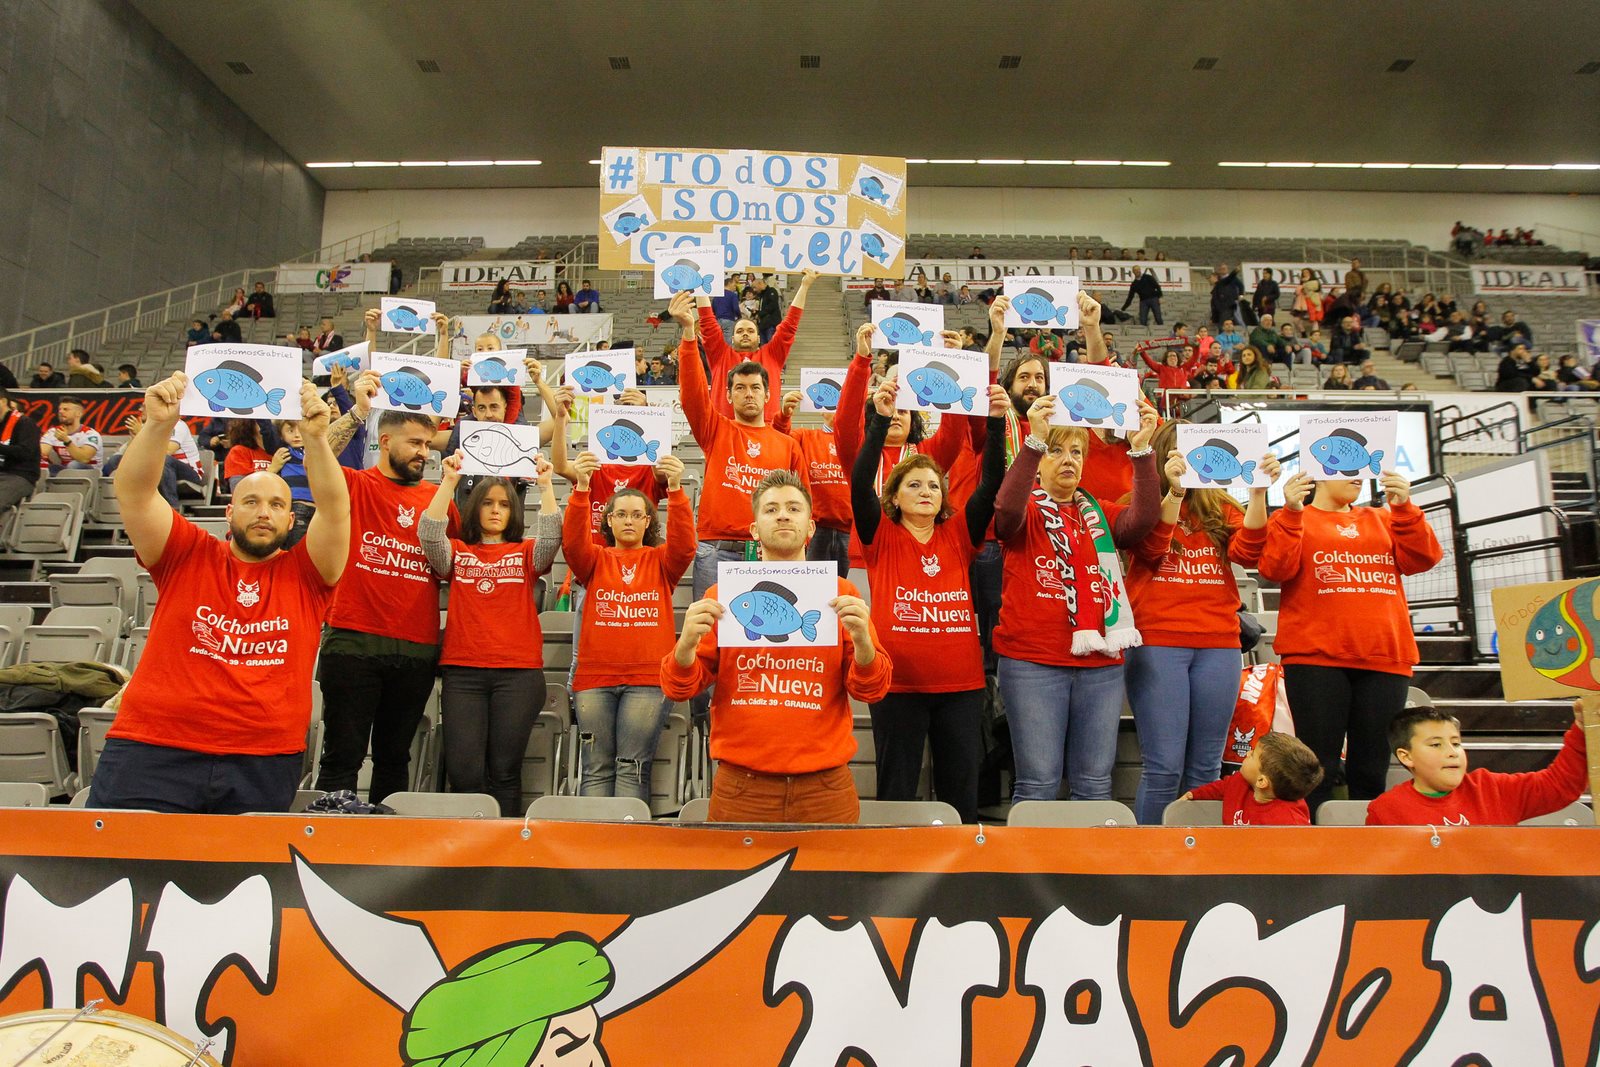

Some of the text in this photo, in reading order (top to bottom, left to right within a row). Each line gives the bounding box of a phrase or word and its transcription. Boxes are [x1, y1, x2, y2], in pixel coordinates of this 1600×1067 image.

[452, 265, 547, 283] IDEAL
[1479, 270, 1580, 288] IDEAL
[193, 347, 294, 360] #TodosSomosGabriel
[905, 348, 983, 363] #TodosSomosGabriel
[377, 355, 454, 369] #TodosSomosGabriel
[1056, 366, 1132, 378] #TodosSomosGabriel
[594, 407, 666, 417] #TodosSomosGabriel
[1306, 415, 1392, 425] #TodosSomosGabriel
[1183, 427, 1262, 435] #TodosSomosGabriel
[1313, 550, 1395, 566] Colchonería
[391, 570, 400, 578] 39
[466, 567, 524, 578] GRANADA
[726, 566, 829, 575] #TodosSomosGabriel
[1344, 566, 1397, 586] Nueva
[596, 588, 659, 603] Colchonería
[896, 586, 968, 603] Colchonería
[1370, 587, 1397, 596] GRANADA
[616, 604, 659, 619] Nueva
[922, 606, 971, 623] Nueva
[1499, 595, 1545, 631] TODOS
[196, 605, 289, 635] Colchonería
[220, 634, 288, 655] Nueva
[246, 658, 285, 667] GRANADA
[760, 673, 823, 698] Nueva
[731, 698, 748, 706] Avda.
[748, 698, 768, 706] Cádiz
[784, 700, 822, 711] GRANADA
